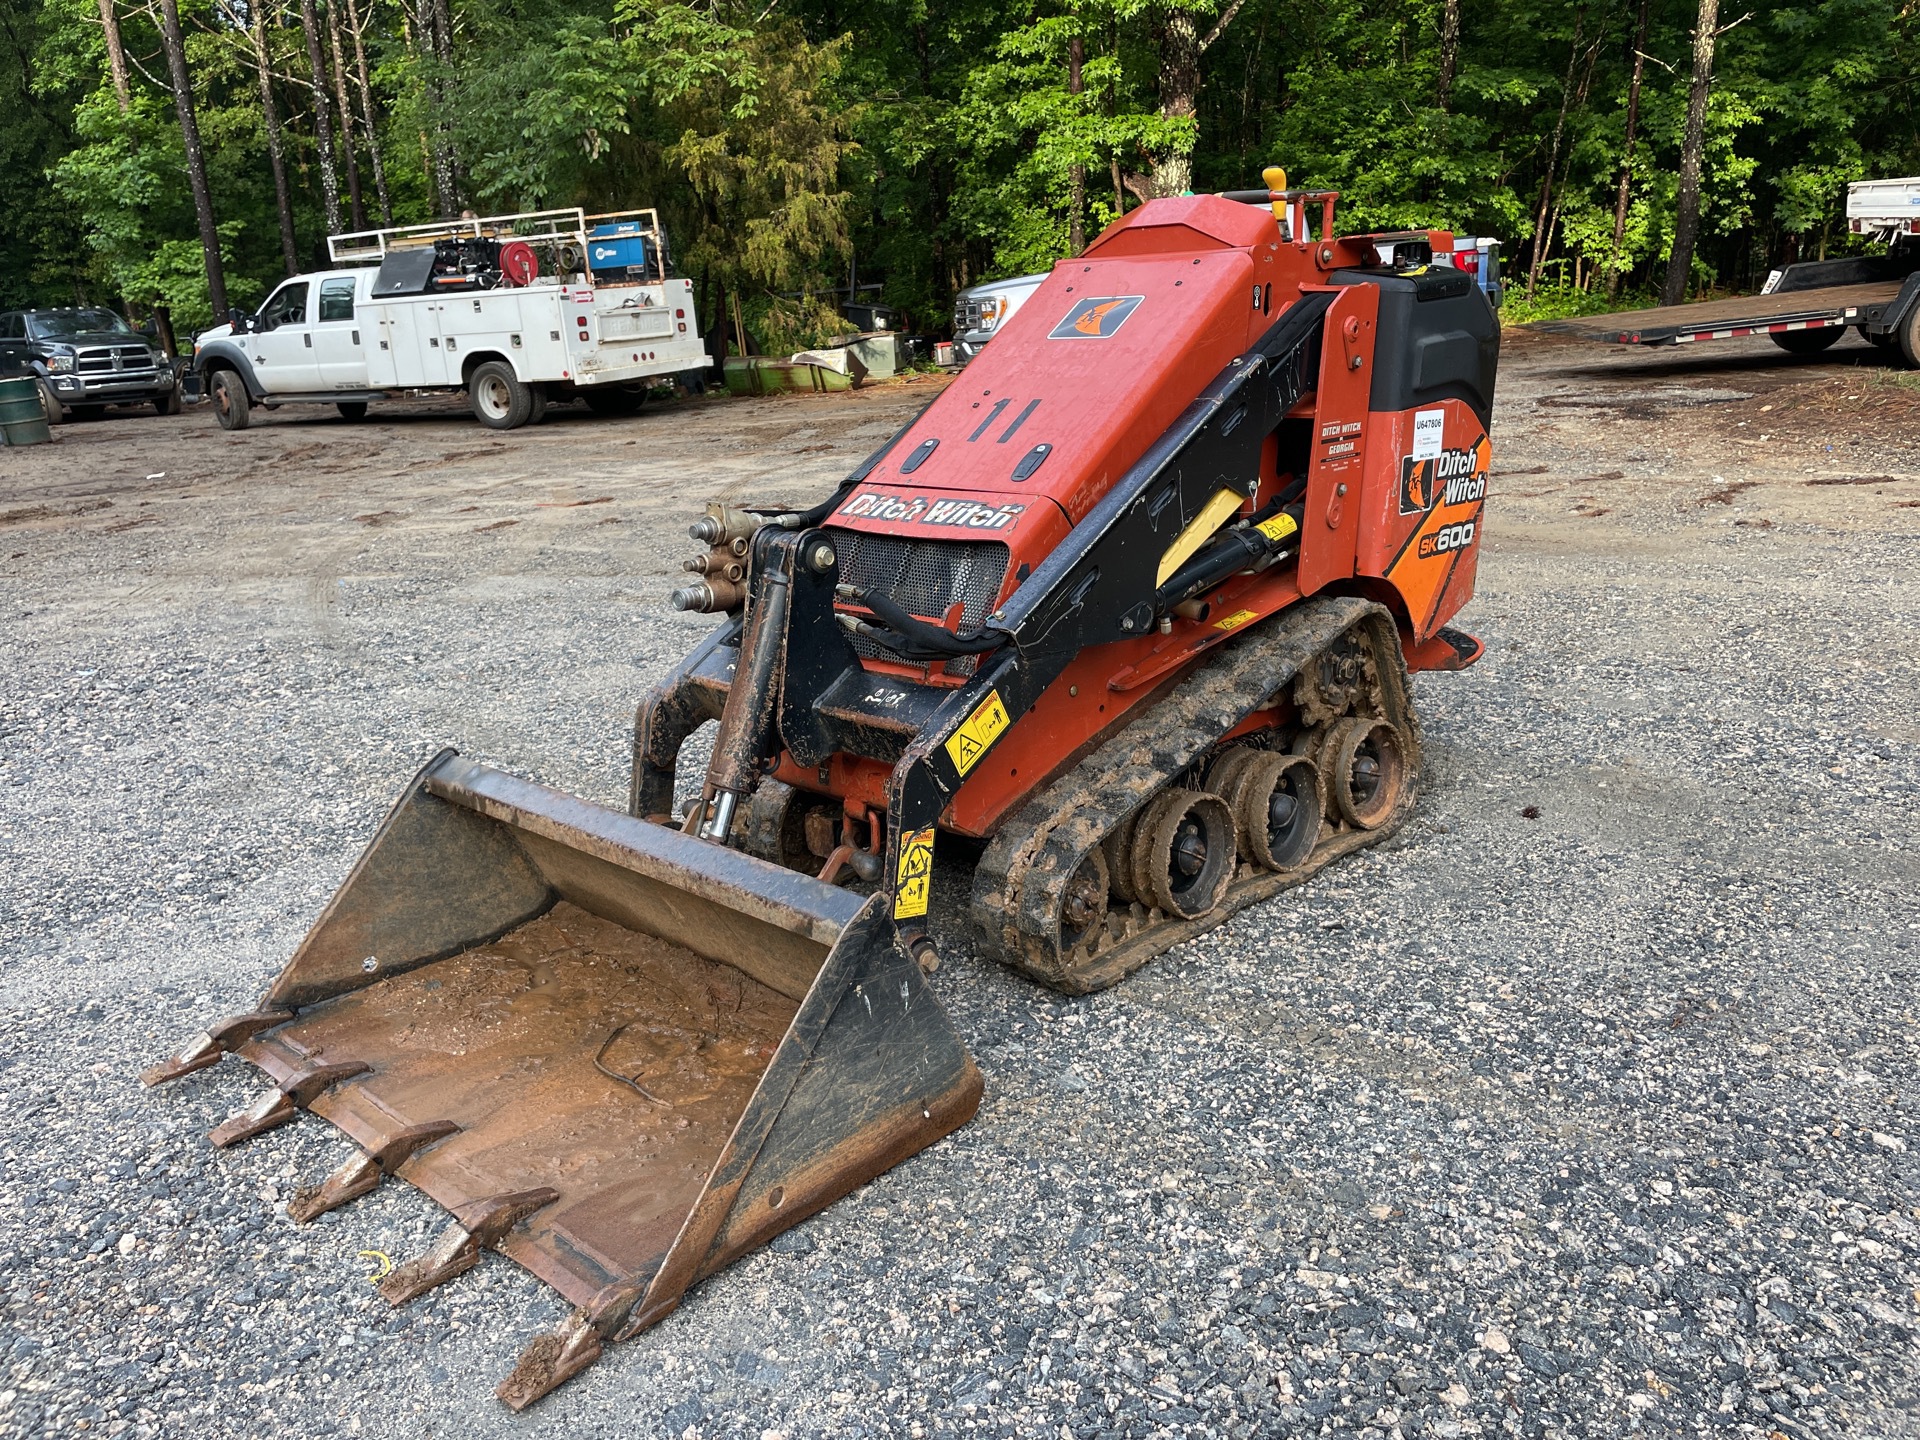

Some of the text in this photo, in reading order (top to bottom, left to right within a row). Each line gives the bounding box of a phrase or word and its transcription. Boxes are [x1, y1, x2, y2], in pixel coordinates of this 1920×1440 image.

[966, 398, 1043, 443] 11
[1322, 425, 1341, 437] DITCH
[1342, 422, 1362, 434] WITCH
[1416, 418, 1442, 430] U647806
[1328, 442, 1355, 455] GEORGIA
[1437, 448, 1477, 478] Ditch
[1445, 474, 1485, 504] Witch
[842, 494, 1015, 528] Ditch Witch
[1419, 523, 1474, 554] SK600
